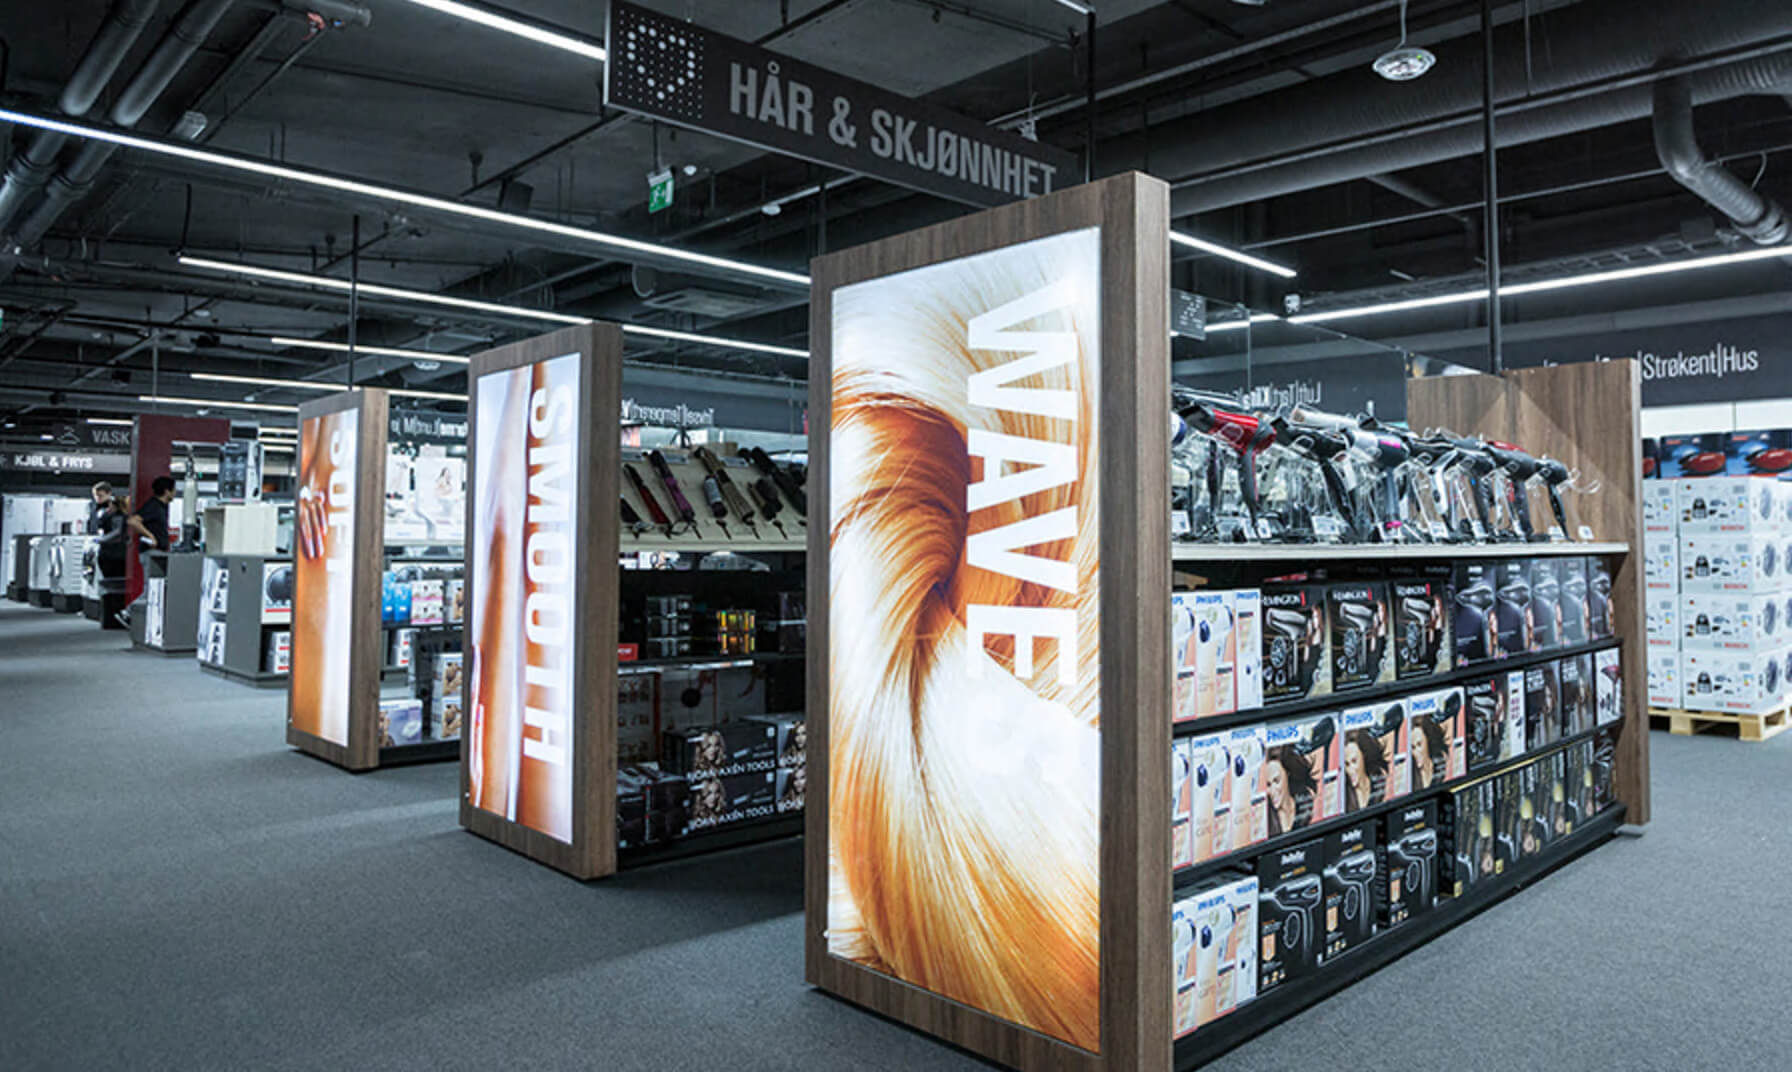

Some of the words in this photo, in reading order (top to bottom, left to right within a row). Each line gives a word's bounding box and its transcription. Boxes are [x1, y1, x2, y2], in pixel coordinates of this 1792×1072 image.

[730, 60, 814, 136] HÅR
[828, 96, 857, 148] &
[870, 109, 1057, 199] SKJØNNHET
[48, 455, 60, 468] &
[62, 456, 94, 469] FRYS
[91, 428, 131, 445] VASK
[326, 429, 355, 573] SOFT
[967, 276, 1079, 688] WAVE
[523, 384, 572, 768] SMOOTH
[1267, 725, 1299, 742] PHILIPS
[1346, 710, 1374, 726] PHILIPS
